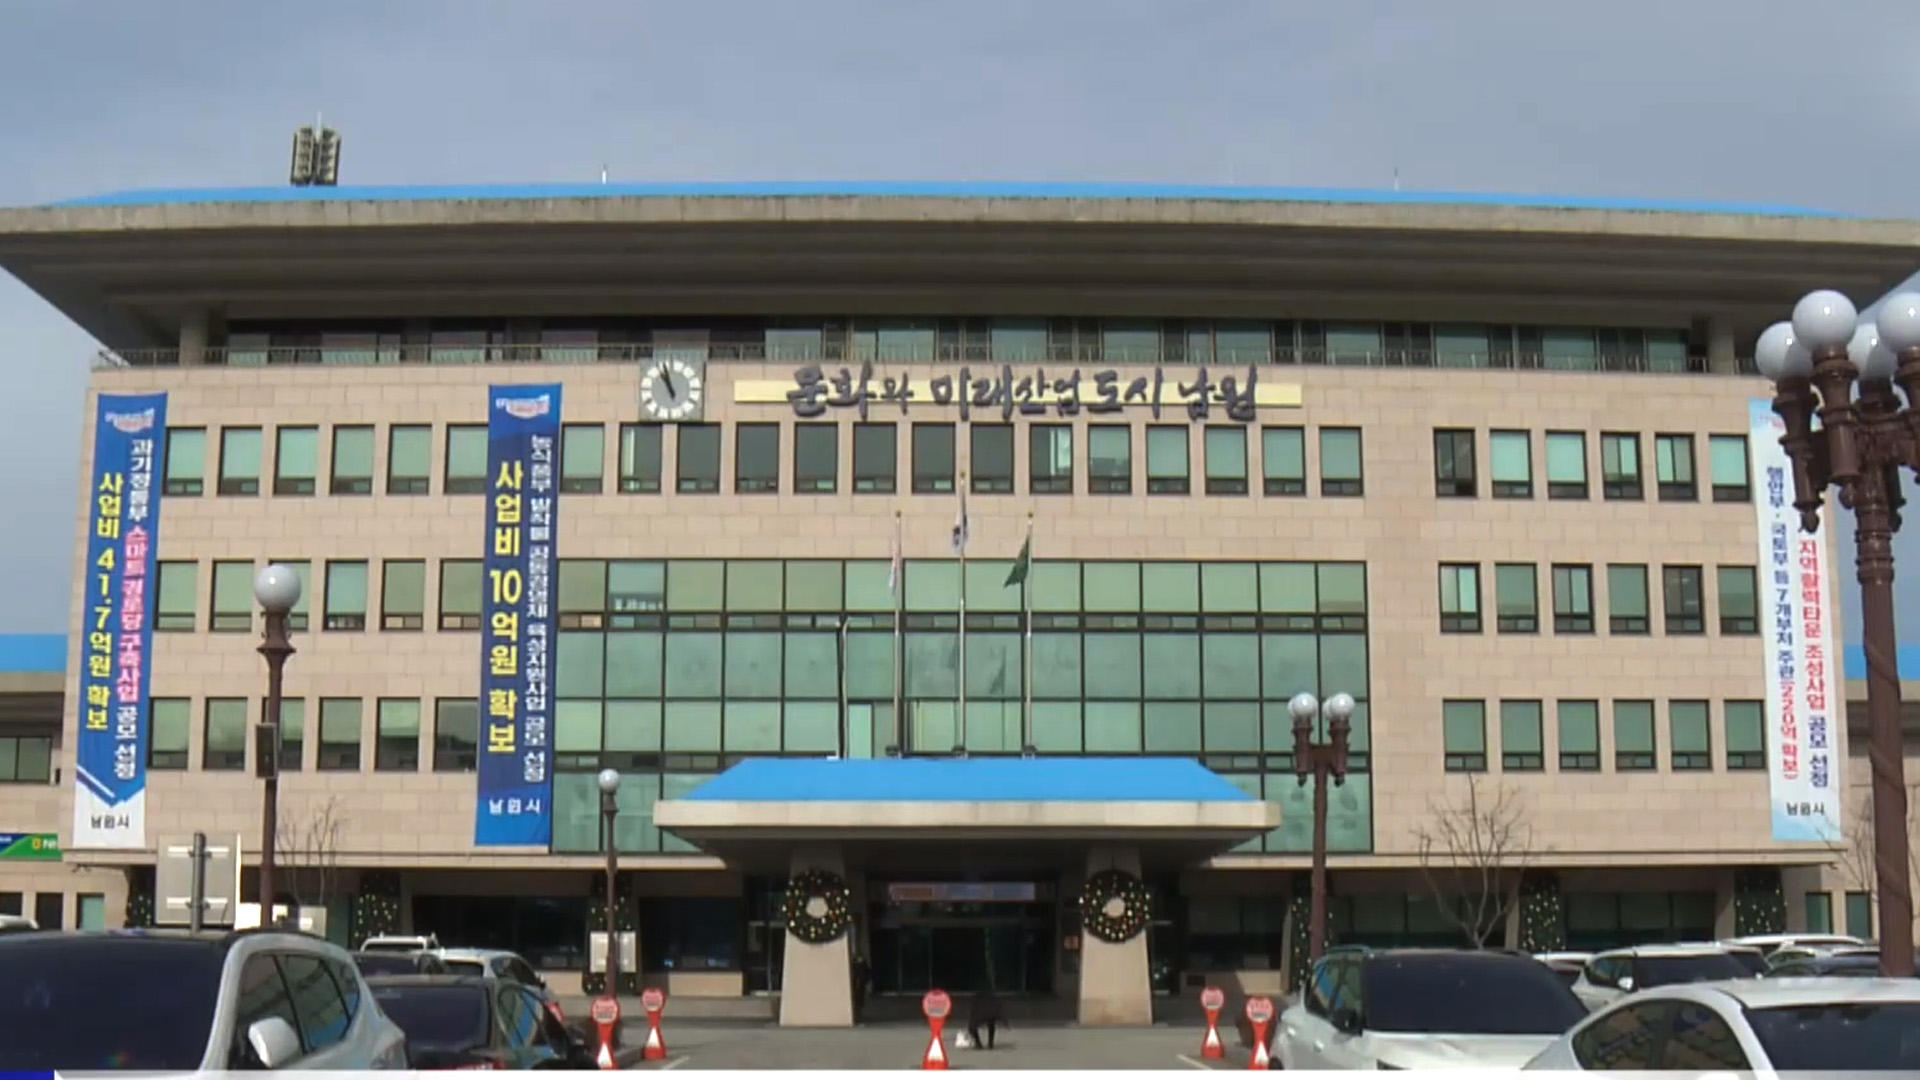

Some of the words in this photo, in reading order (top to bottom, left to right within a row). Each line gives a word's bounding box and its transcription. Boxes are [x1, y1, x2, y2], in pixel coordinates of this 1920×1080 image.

[786, 359, 914, 421] 문화와
[1177, 363, 1259, 422] 남원
[97, 472, 124, 539] 사업비
[496, 460, 524, 557] 사업비
[1804, 644, 1826, 710] 조성사업
[86, 686, 110, 731] 확보
[116, 705, 138, 739] 공모
[487, 688, 518, 753] 확보
[1808, 716, 1828, 749] 공모
[114, 743, 137, 780] 선정
[1810, 754, 1828, 788] 선정
[90, 814, 130, 829] 남원시
[488, 798, 541, 815] 남원시
[1786, 802, 1826, 817] 남원시
